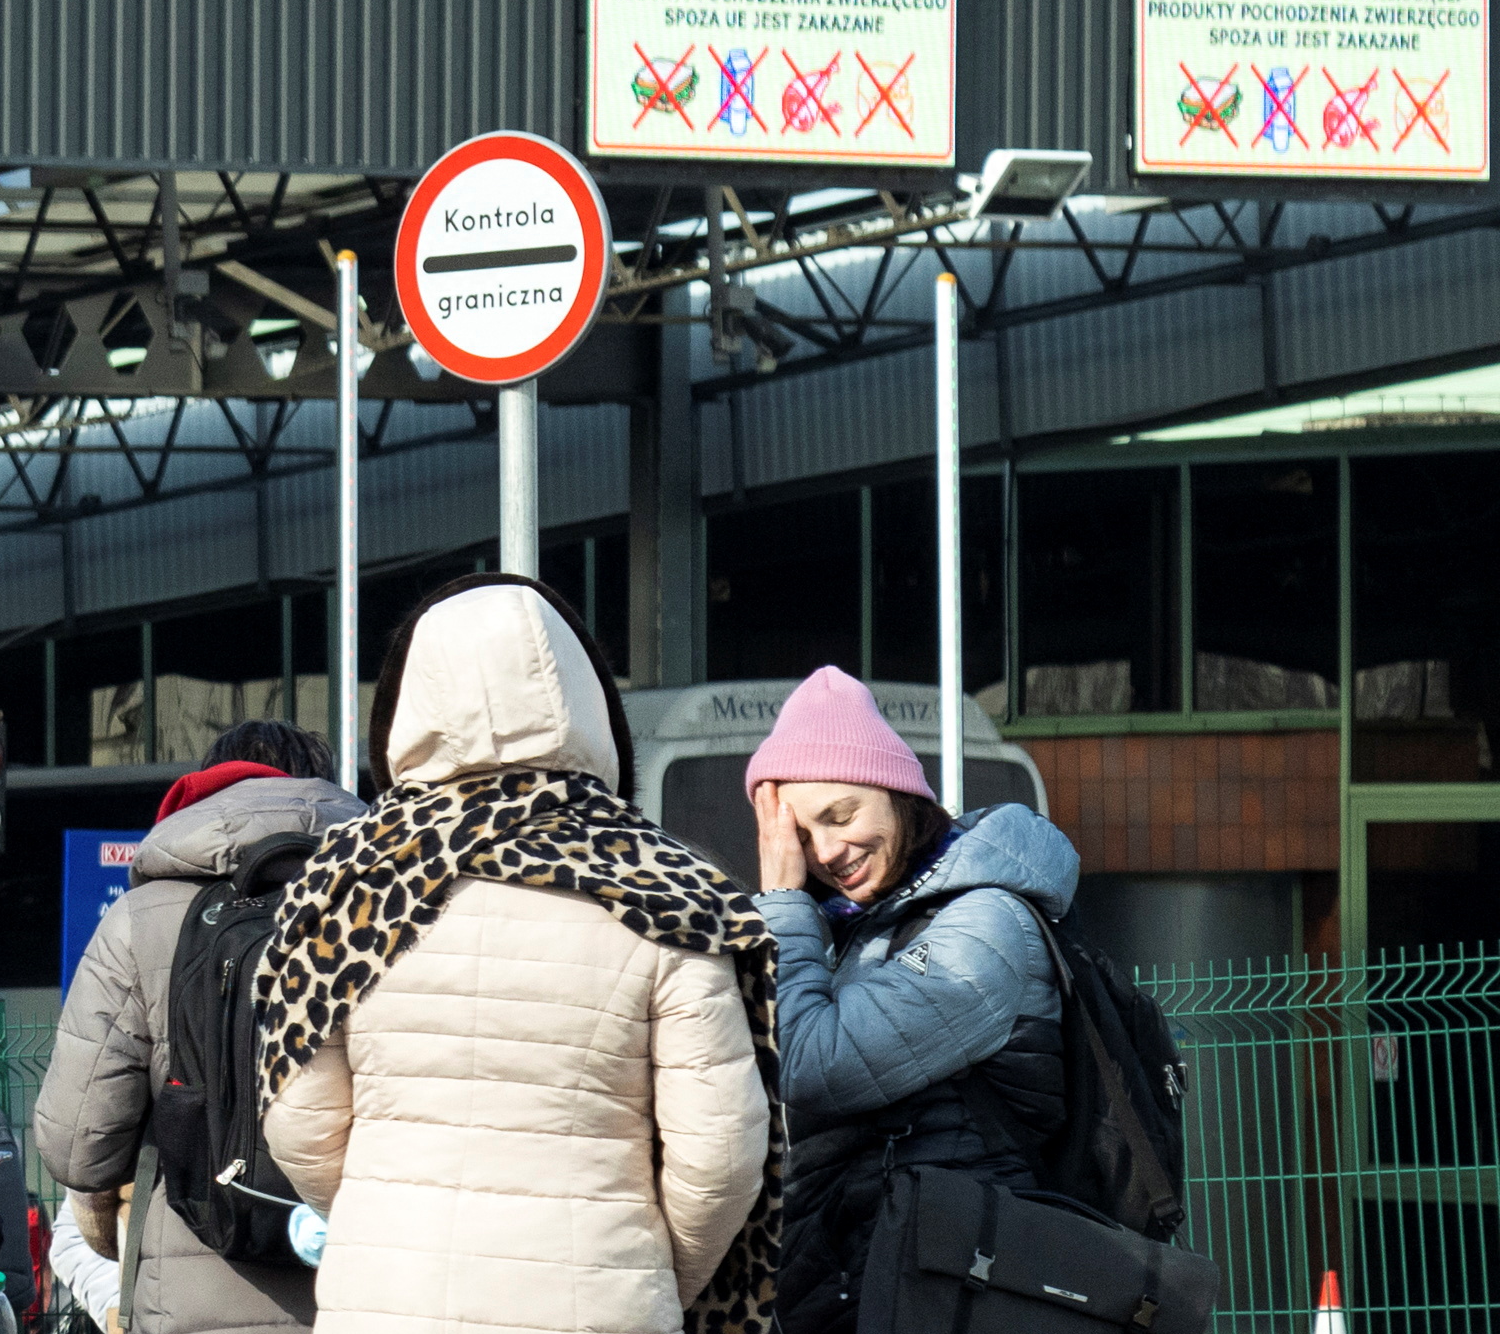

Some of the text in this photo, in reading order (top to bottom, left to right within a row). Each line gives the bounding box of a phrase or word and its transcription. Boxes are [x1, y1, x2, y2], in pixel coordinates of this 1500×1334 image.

[665, 8, 885, 33] SPOZA UE JEST ZAKAZANE
[1149, 1, 1480, 29] PRODUKTY POCHODZENIA ZWIERZĘCEGO
[1210, 28, 1420, 51] SPOZA UE JEST ZAKAZANE
[445, 202, 555, 232] Kontrola
[438, 284, 563, 319] graniczna
[104, 847, 137, 863] КУР
